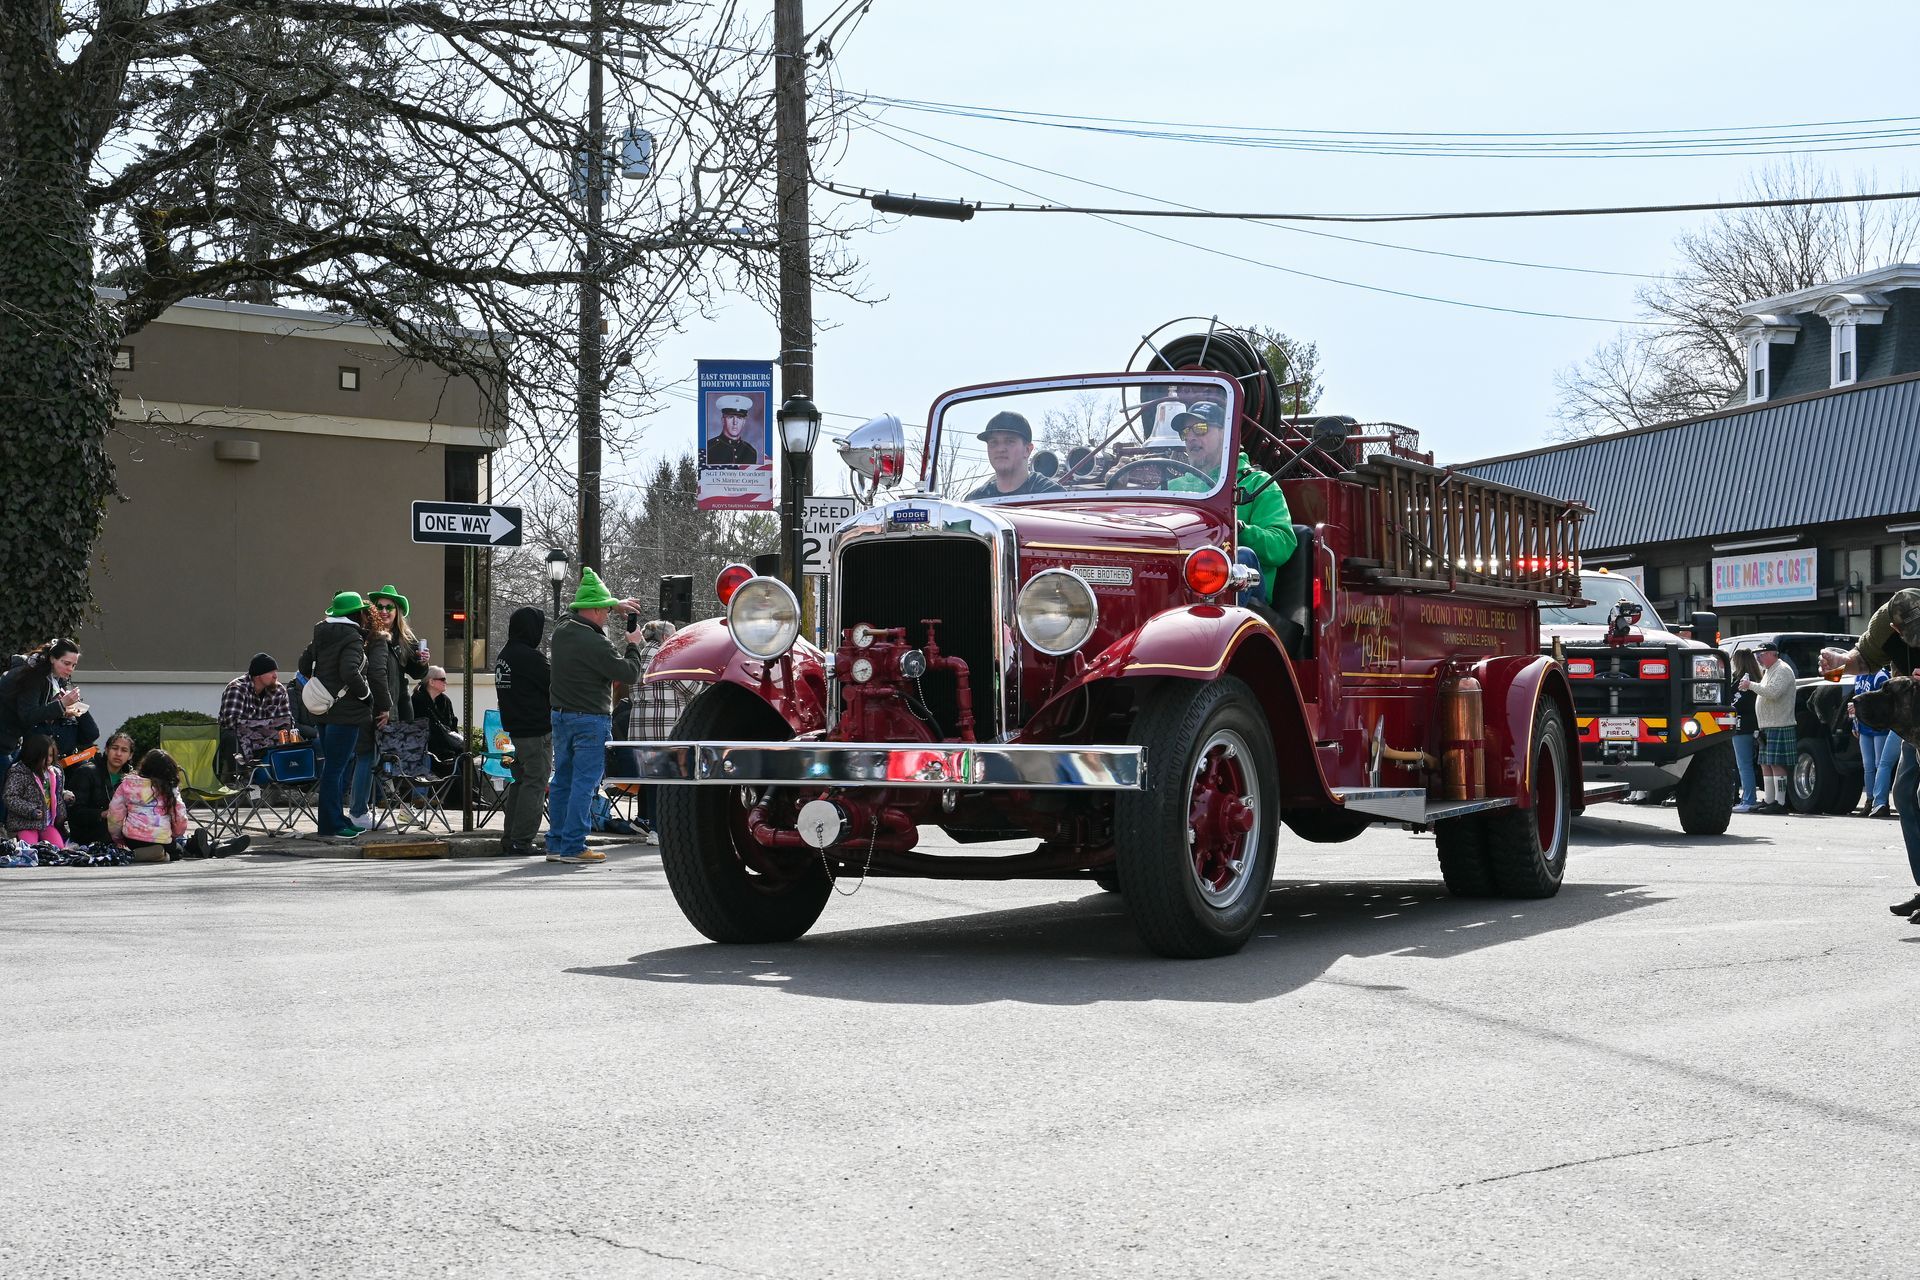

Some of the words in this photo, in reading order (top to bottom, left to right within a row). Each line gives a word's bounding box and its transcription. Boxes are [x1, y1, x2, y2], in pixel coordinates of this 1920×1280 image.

[700, 373, 718, 381] EAST
[719, 373, 771, 381] STROUDSBURG
[701, 380, 741, 388] HOMETOWN
[742, 380, 771, 388] HEROES
[801, 506, 850, 518] SPEED
[425, 514, 457, 532] ONE
[461, 516, 491, 533] WAY
[1903, 549, 1920, 577] S
[1097, 569, 1130, 580] BROTHERS
[1716, 564, 1740, 590] ELLIE
[1743, 561, 1775, 587] MAE'S
[1776, 557, 1813, 584] CLOSET
[1341, 586, 1393, 643] Organized
[1420, 603, 1451, 625] POCONO
[1361, 633, 1390, 669] 1940
